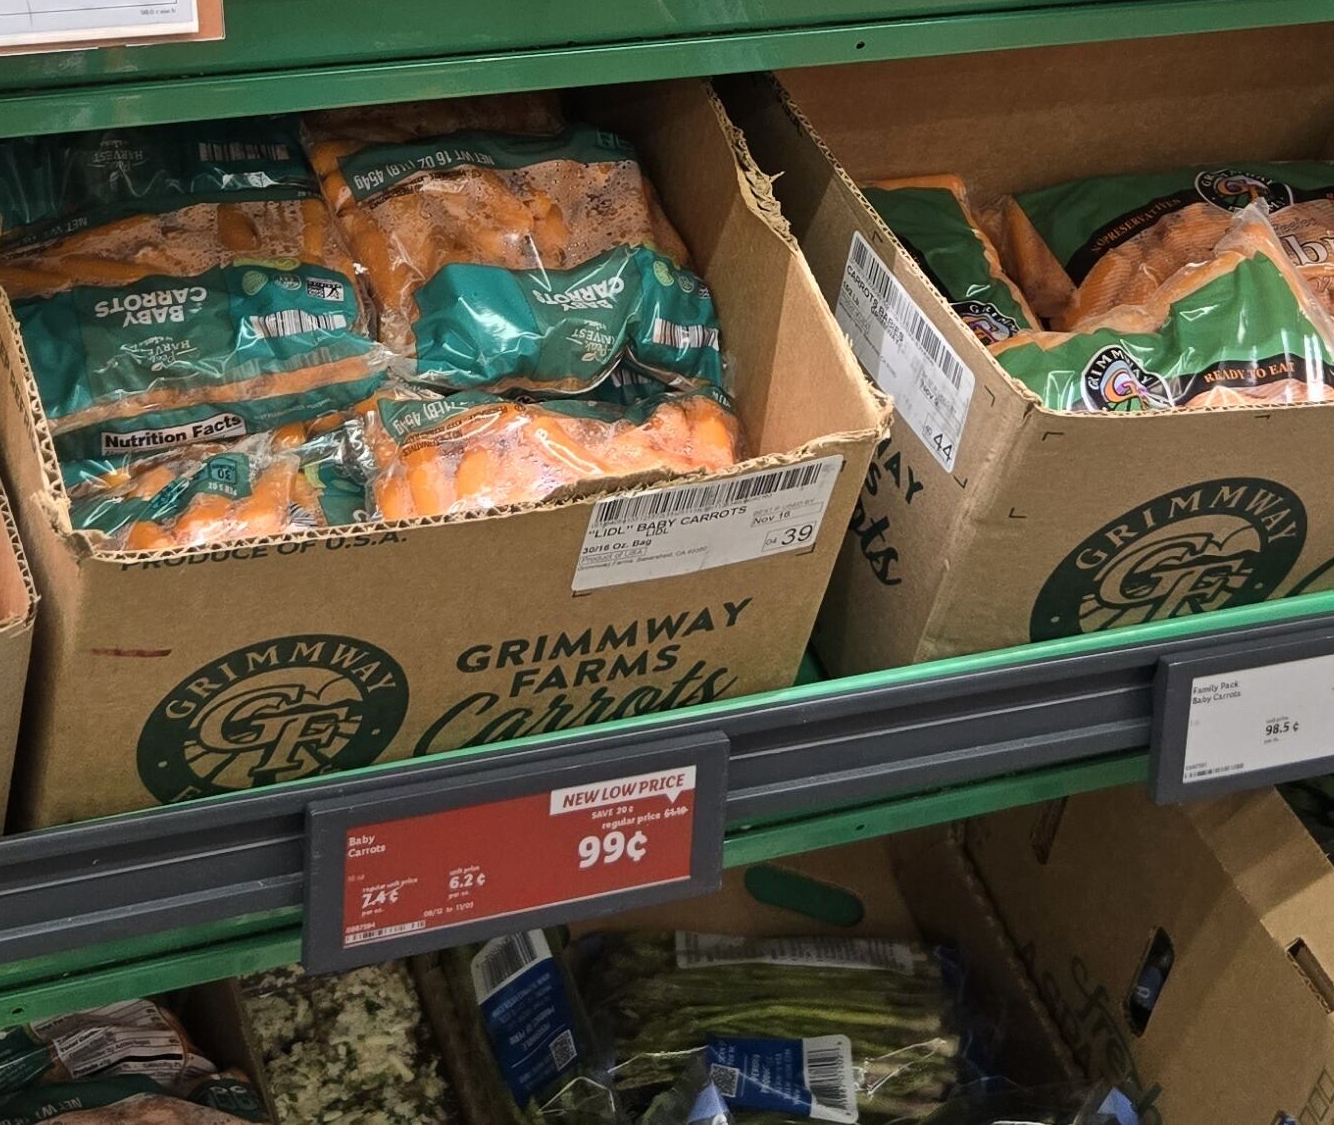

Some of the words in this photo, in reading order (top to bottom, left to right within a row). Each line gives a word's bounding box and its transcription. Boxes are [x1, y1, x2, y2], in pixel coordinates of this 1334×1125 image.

[434, 150, 452, 167] 16
[354, 172, 382, 191] 454g
[94, 286, 208, 318] CARROTS
[122, 305, 185, 327] BABY
[1203, 368, 1246, 384] READY
[1250, 366, 1267, 381] TO
[1269, 360, 1296, 376] EAT
[104, 424, 188, 450] Nutrition
[192, 415, 243, 441] Facts
[933, 433, 953, 462] 44
[588, 525, 634, 539] "LIDL"
[636, 519, 676, 533] BABY
[679, 505, 748, 526] CARROTS
[753, 516, 775, 526] Nov
[1073, 486, 1304, 571] GRIMMWAY
[277, 538, 316, 556] OF
[321, 528, 408, 551] U.S.A.
[632, 539, 652, 550] Bag
[781, 524, 813, 546] 39
[456, 597, 754, 673] GRIMMWAY
[165, 641, 397, 722] GRIMMWAY
[509, 644, 682, 698] FARMS
[1192, 694, 1212, 706] Baby
[1213, 690, 1241, 702] Carrots
[1193, 683, 1218, 696] Family
[1220, 680, 1239, 692] Pack
[413, 659, 739, 756] Carrots
[1265, 721, 1291, 736] 98.5
[563, 791, 599, 808] NEW
[601, 784, 636, 801] LOW
[638, 773, 685, 795] PRICE
[591, 808, 613, 819] SAVE
[616, 806, 627, 815] 20
[601, 817, 636, 830] regular
[637, 812, 662, 827] price
[348, 835, 376, 848] Baby
[348, 843, 386, 858] Carrots
[578, 829, 648, 869] 99¢
[449, 874, 473, 889] 6.2
